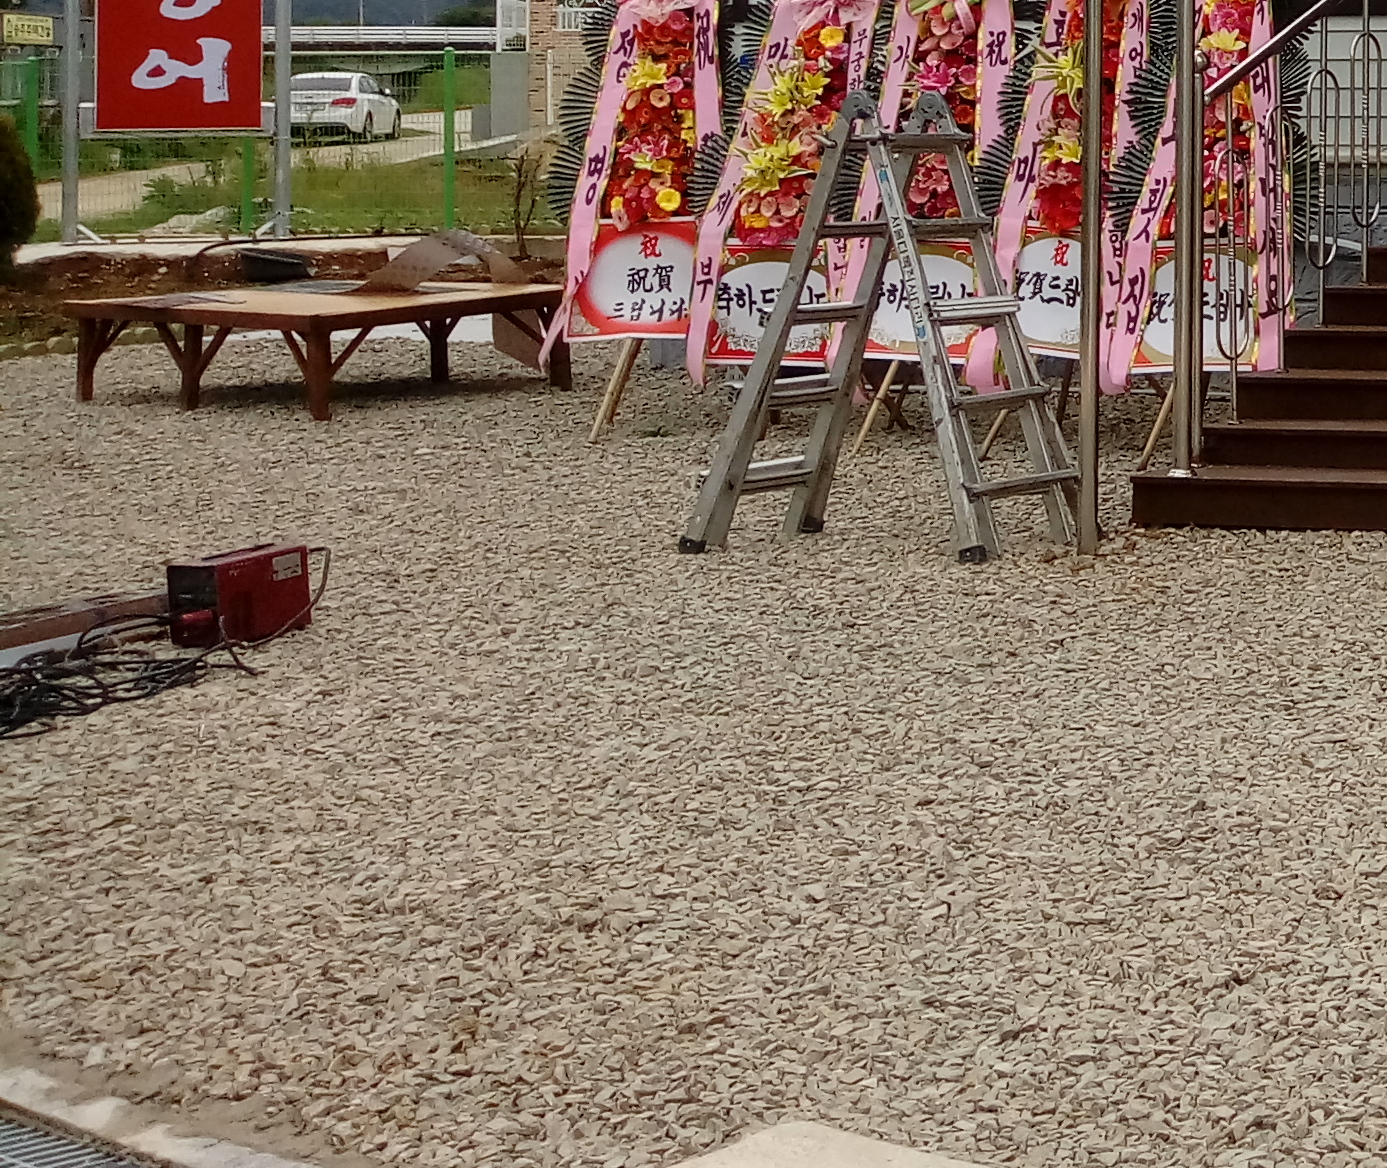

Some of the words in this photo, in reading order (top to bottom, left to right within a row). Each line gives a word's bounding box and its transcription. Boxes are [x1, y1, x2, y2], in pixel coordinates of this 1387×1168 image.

[696, 8, 715, 71] 祝
[985, 30, 1009, 68] 祝
[637, 232, 663, 260] 祝
[1049, 239, 1072, 267] 祝
[626, 263, 675, 295] 祝賀
